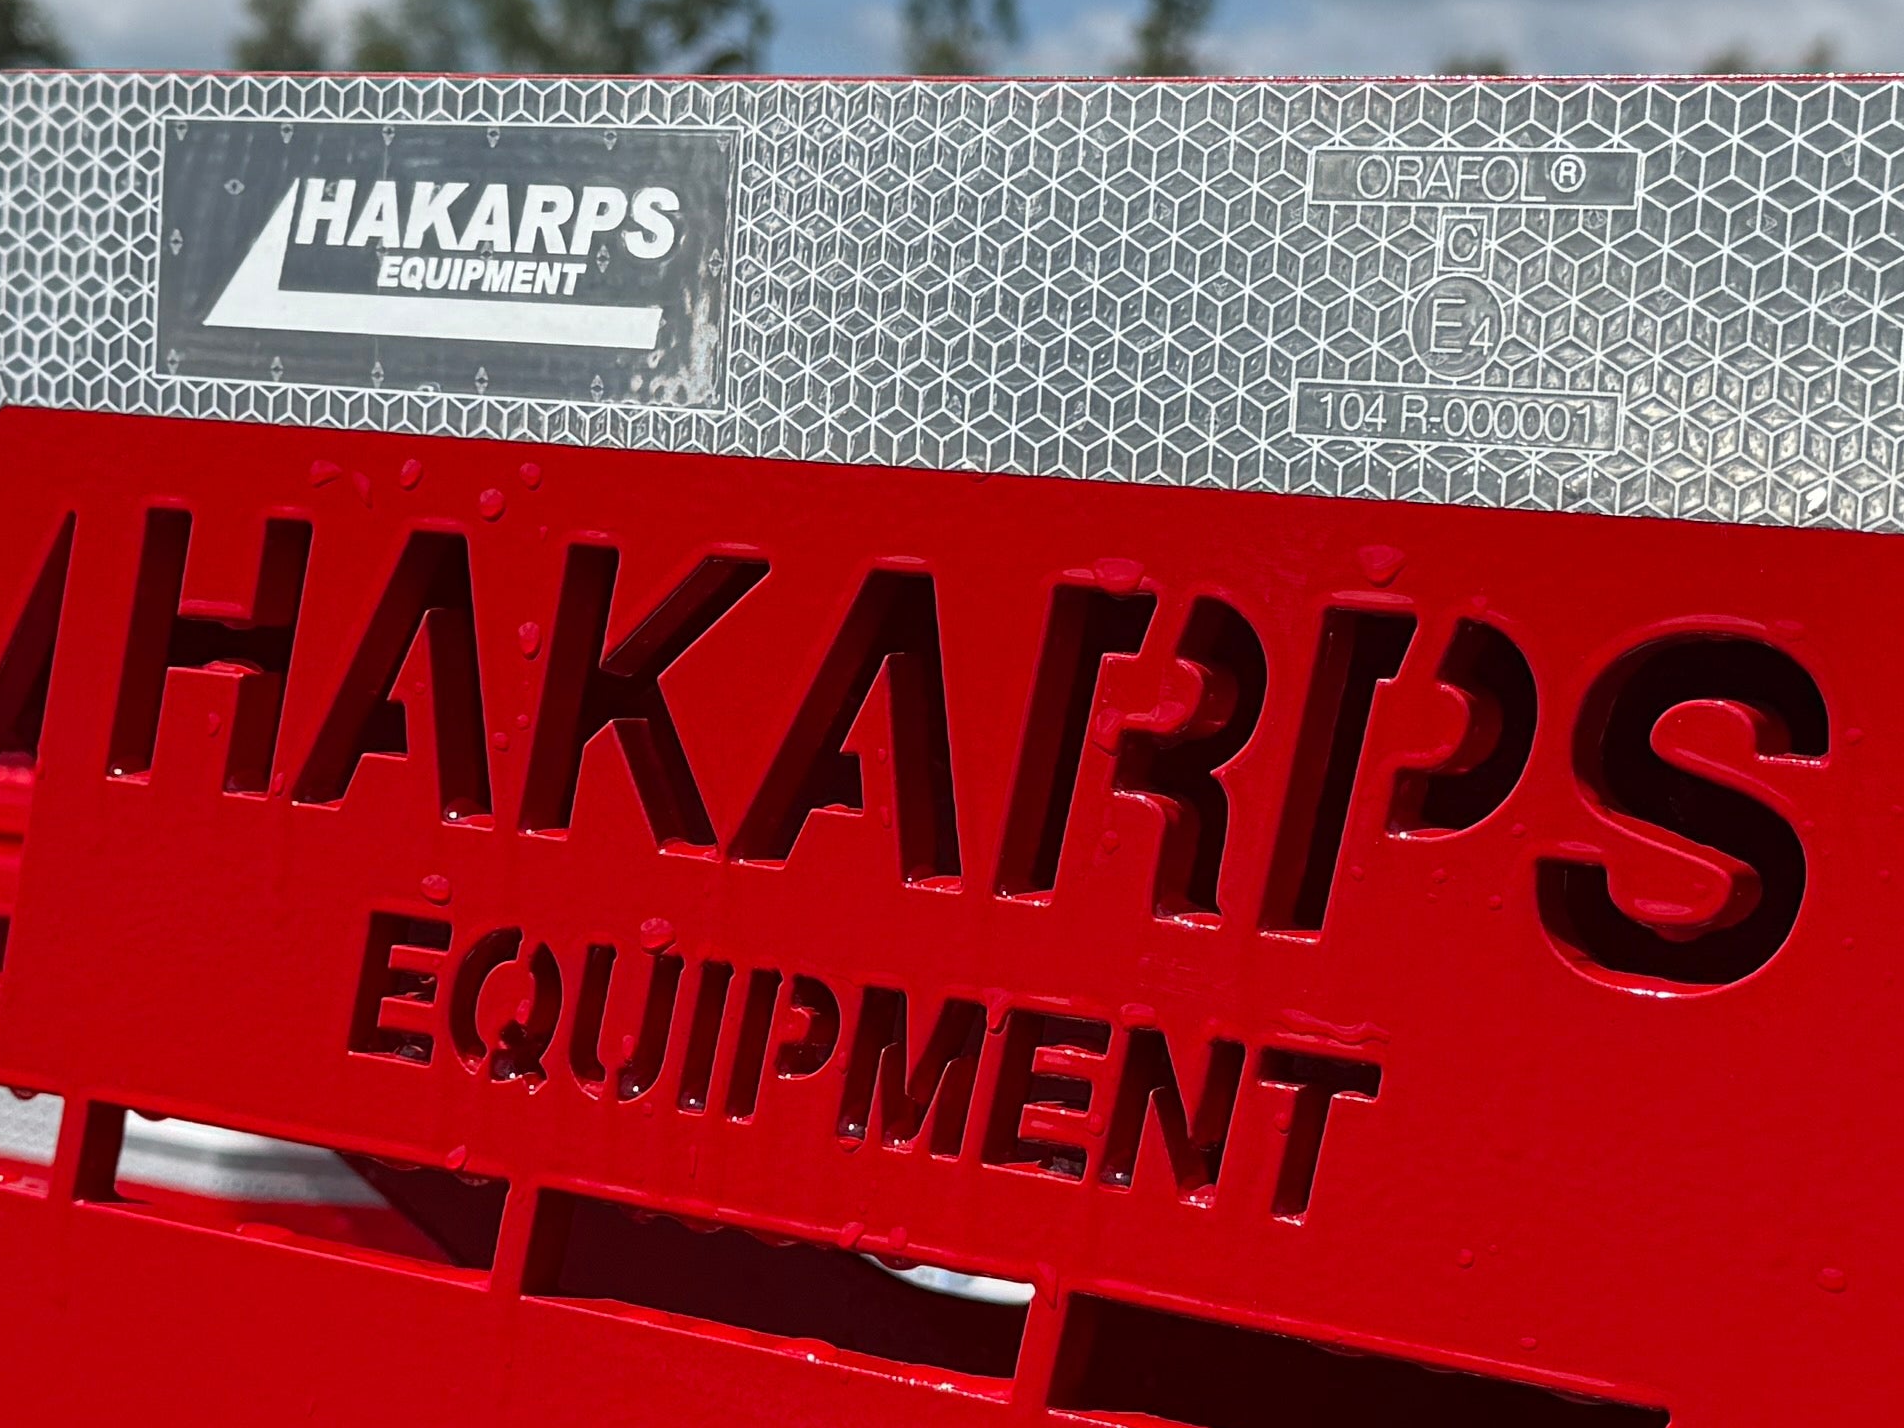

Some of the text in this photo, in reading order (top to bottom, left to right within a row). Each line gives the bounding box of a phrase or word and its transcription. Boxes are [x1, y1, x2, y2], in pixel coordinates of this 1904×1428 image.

[295, 178, 680, 259] HAKARPS
[1447, 224, 1479, 262] C
[376, 255, 587, 296] EQUIPMENT
[1318, 392, 1596, 443] 104 R-000001
[106, 506, 1833, 996] HAKARPS
[347, 910, 1384, 1226] EQUIPMENT
